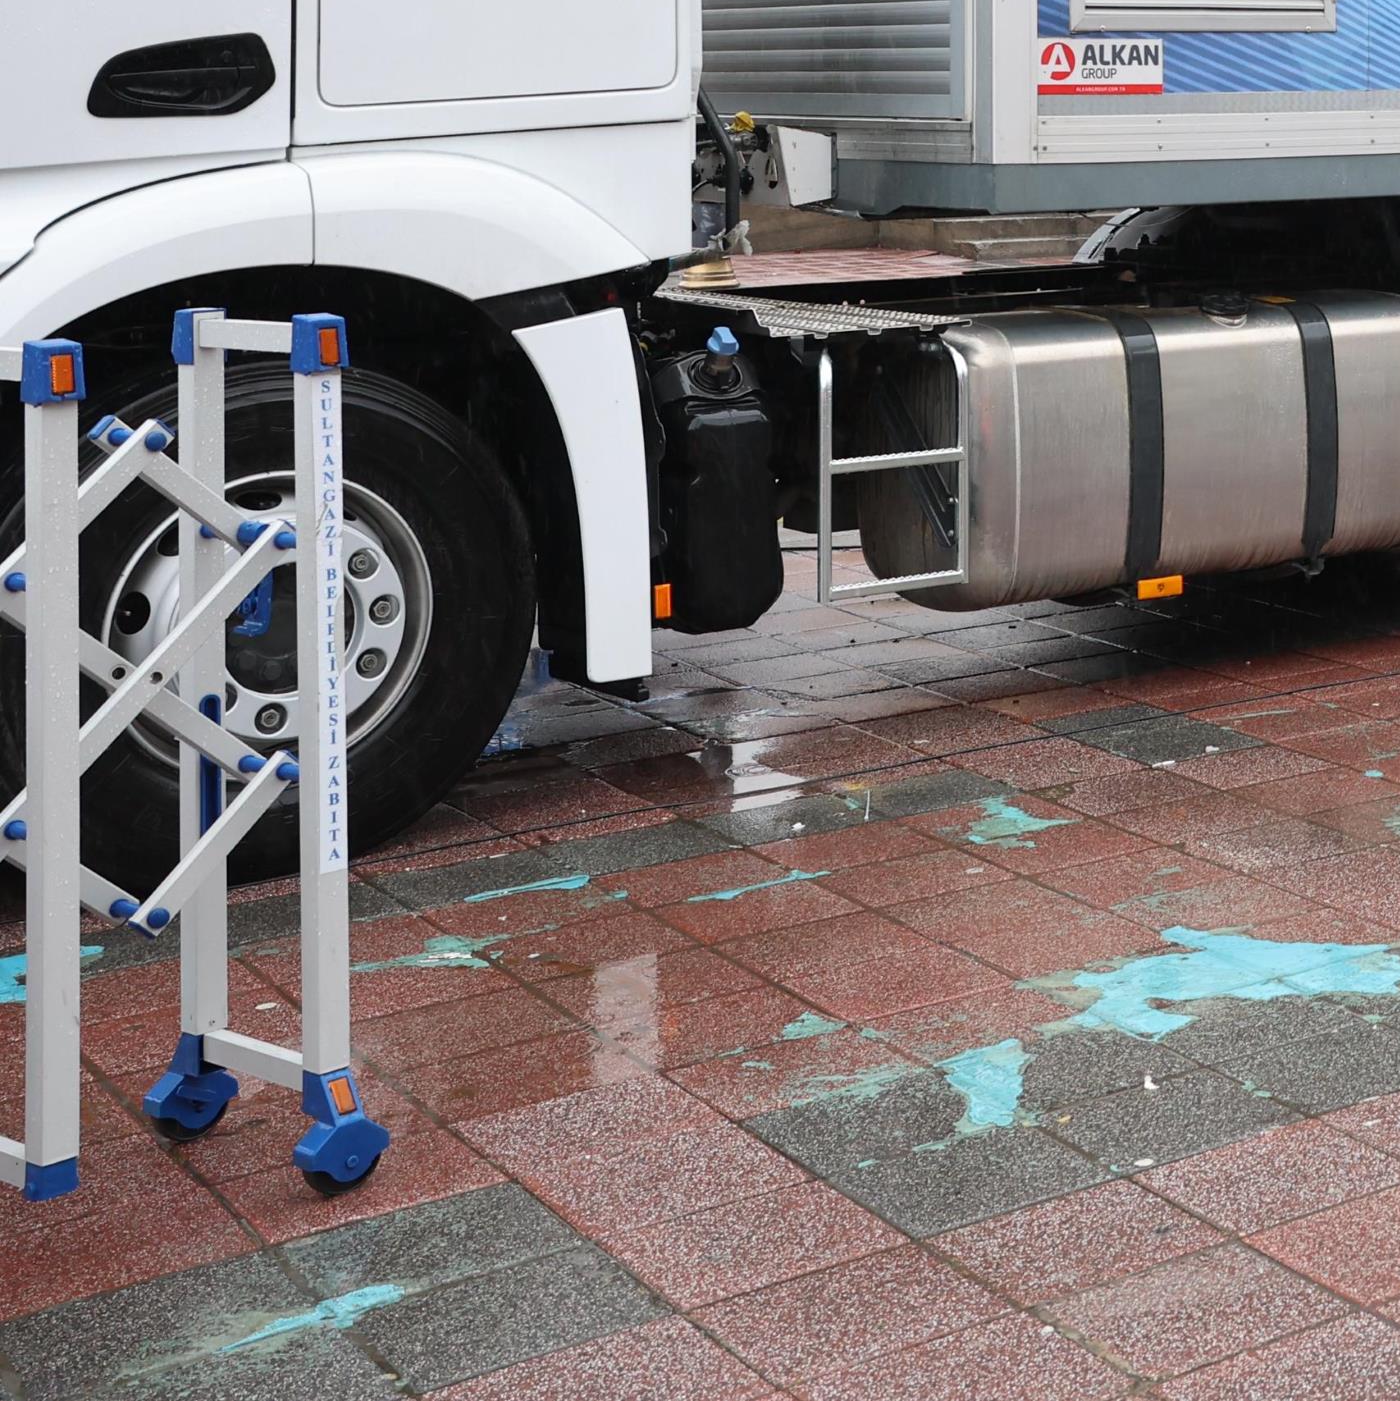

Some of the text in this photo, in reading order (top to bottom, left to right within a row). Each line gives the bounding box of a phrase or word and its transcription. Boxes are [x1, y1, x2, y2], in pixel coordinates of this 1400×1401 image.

[1081, 44, 1159, 66] ALKAN
[1081, 68, 1117, 79] GROUP
[320, 379, 337, 557] SULTANGAZİ
[327, 757, 341, 862] ZABITA
